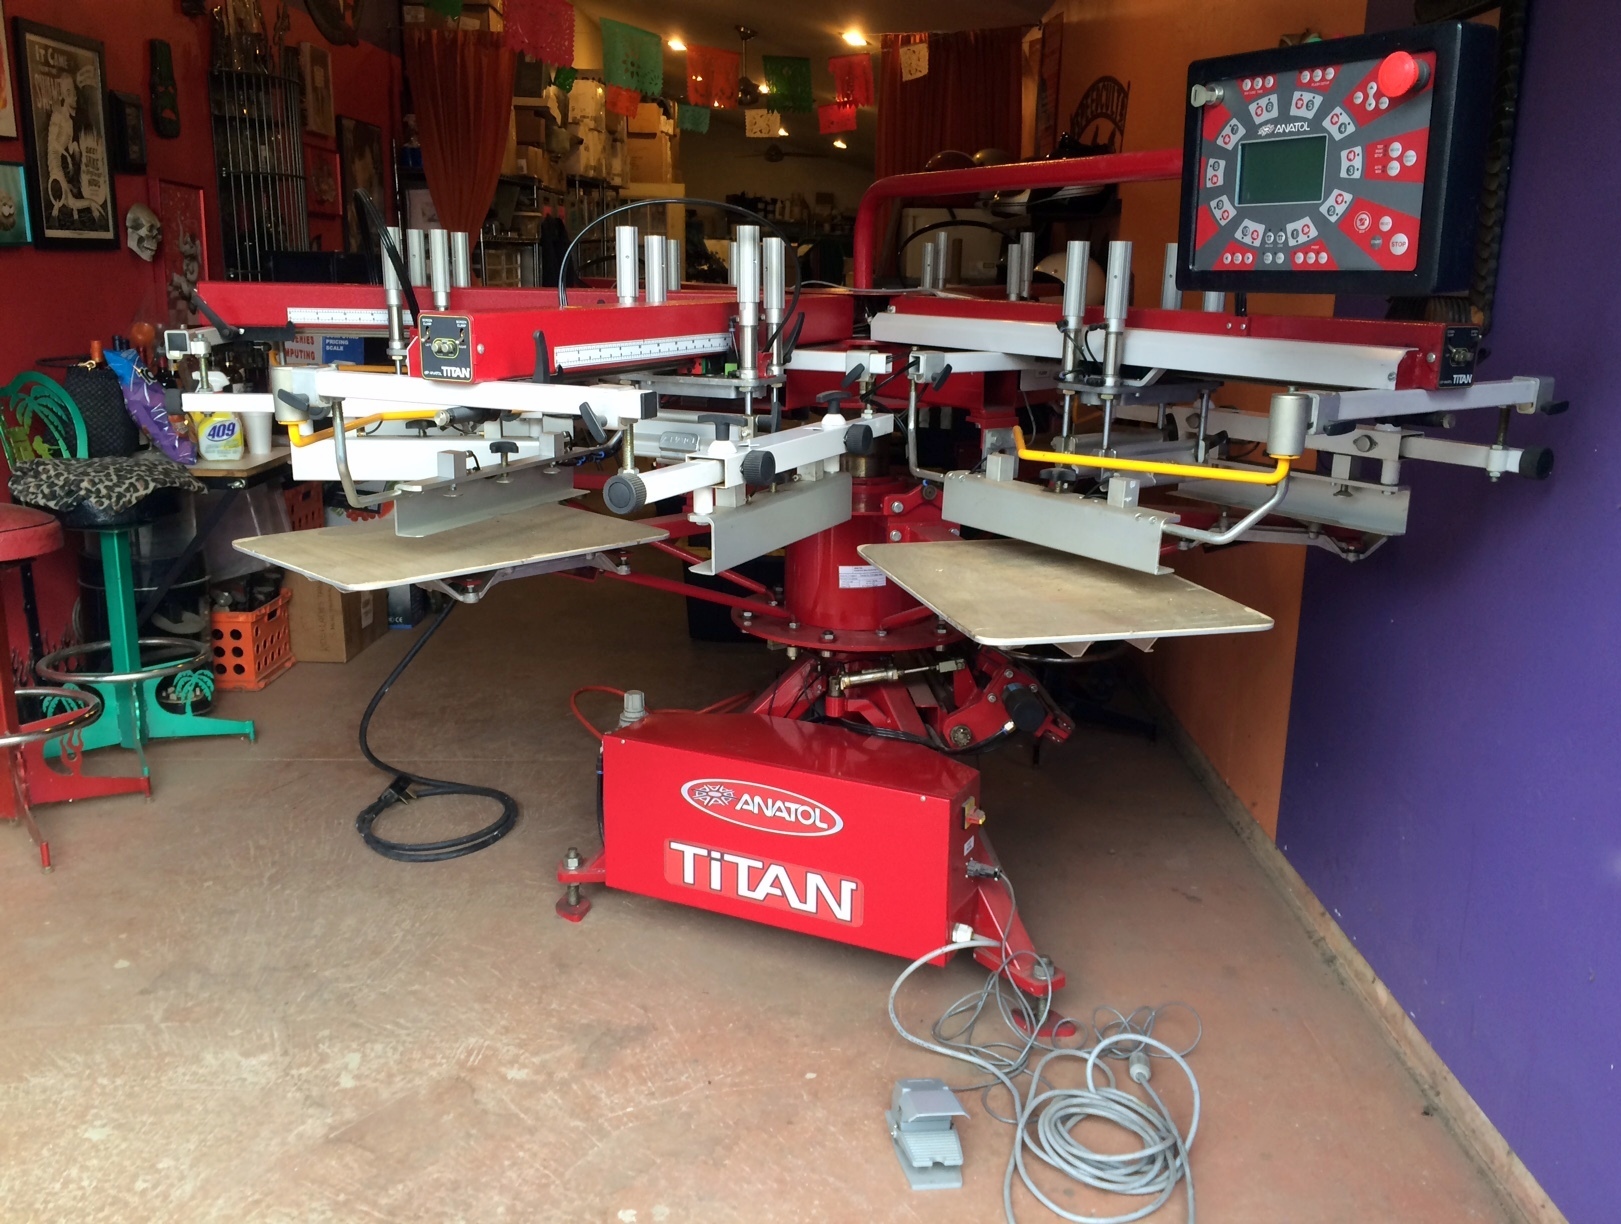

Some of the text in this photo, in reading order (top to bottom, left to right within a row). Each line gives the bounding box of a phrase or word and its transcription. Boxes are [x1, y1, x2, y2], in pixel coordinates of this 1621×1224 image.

[1274, 122, 1310, 133] ANATOL
[284, 347, 316, 361] MPUTING
[441, 366, 470, 378] TITAN
[1453, 374, 1473, 384] TITAN
[207, 422, 236, 439] 409
[735, 793, 829, 830] ANATOL
